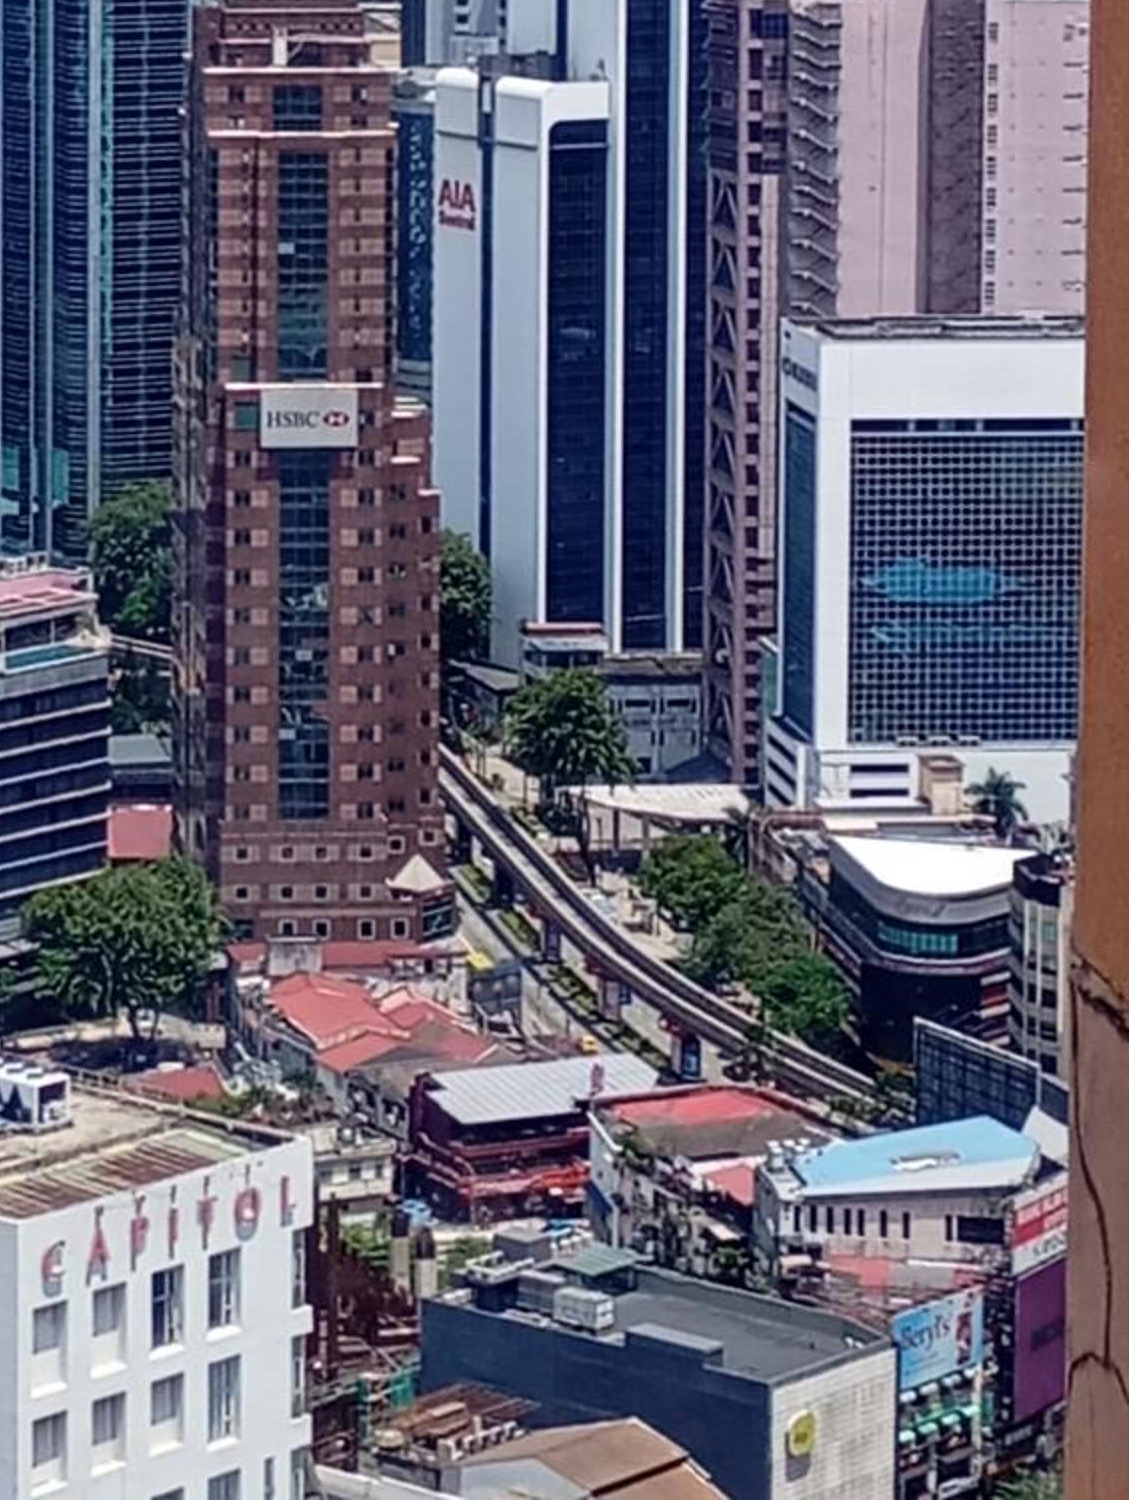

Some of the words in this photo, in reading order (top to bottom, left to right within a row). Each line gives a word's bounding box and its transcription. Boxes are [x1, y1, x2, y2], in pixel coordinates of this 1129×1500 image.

[438, 179, 476, 212] AIA
[267, 410, 321, 428] HSBC
[40, 1174, 297, 1292] CAPITOL
